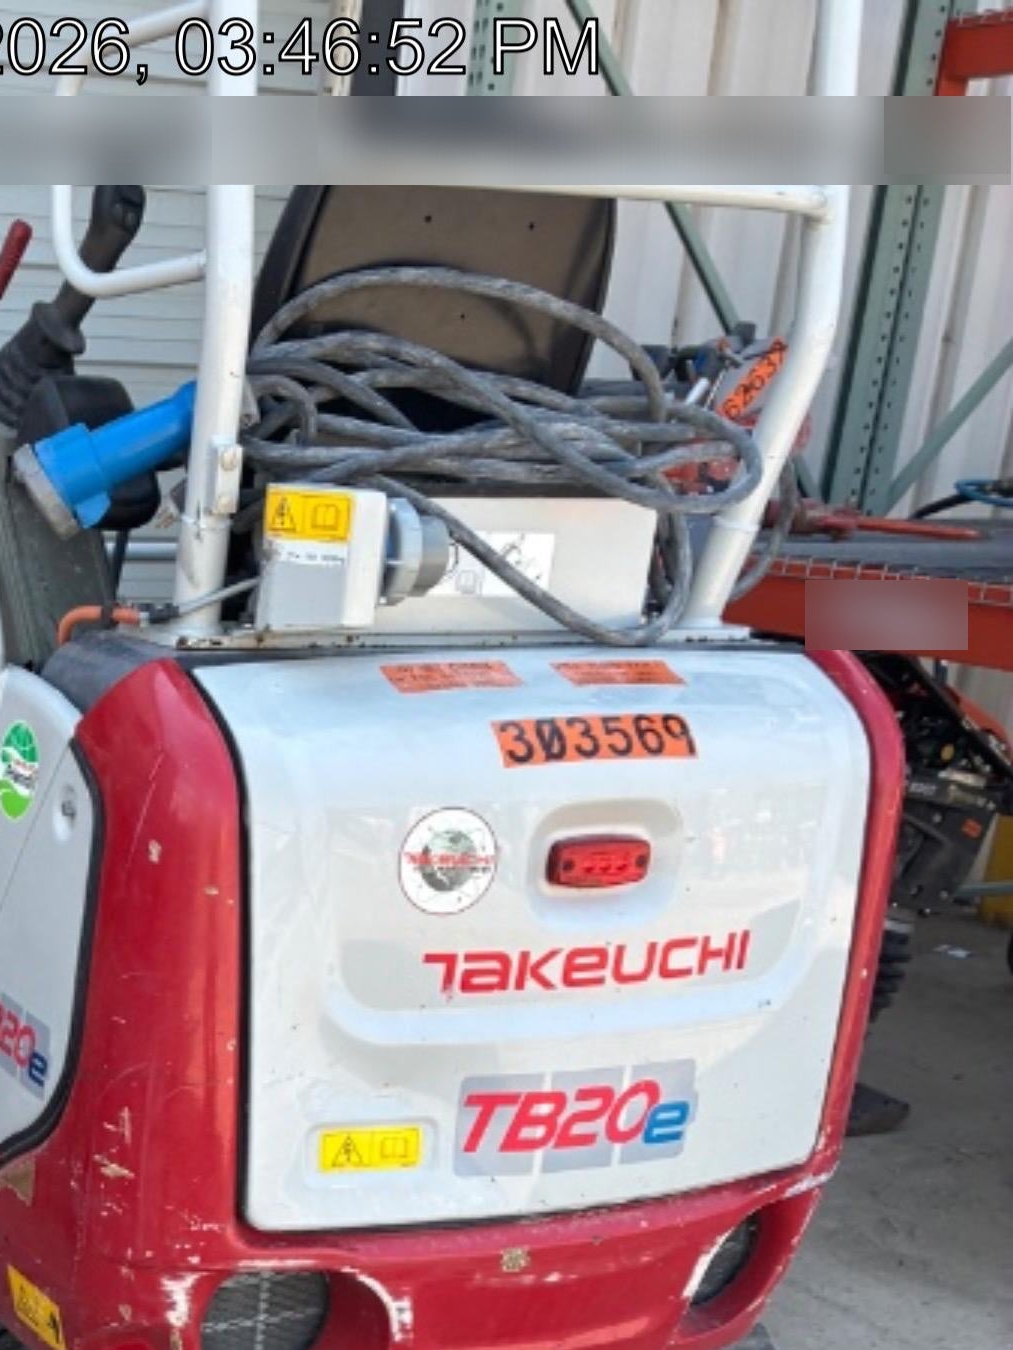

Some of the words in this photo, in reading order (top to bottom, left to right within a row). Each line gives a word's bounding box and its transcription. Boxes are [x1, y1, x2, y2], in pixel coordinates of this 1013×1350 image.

[499, 713, 697, 764] 303569
[422, 929, 750, 996] TAKEUCHI
[462, 1079, 690, 1153] TB20e
